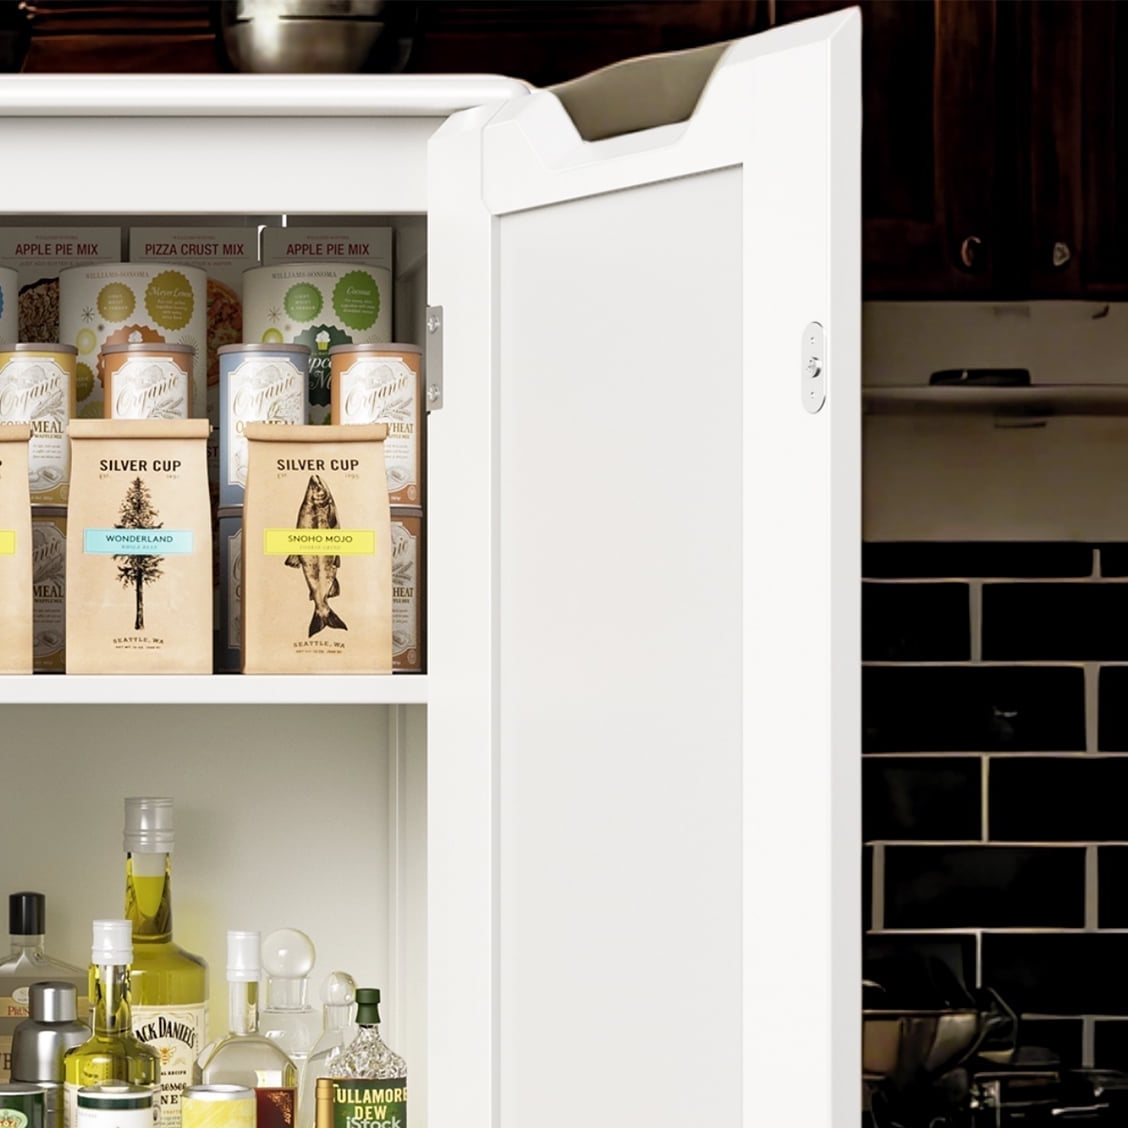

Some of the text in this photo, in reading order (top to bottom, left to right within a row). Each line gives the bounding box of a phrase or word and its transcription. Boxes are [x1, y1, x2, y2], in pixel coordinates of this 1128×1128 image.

[15, 243, 99, 256] APPLE PIE MIX
[144, 243, 245, 256] PIZZA CRUST MIX
[286, 243, 370, 256] APPLE PIE MIX
[116, 372, 179, 418] Organic
[233, 372, 295, 417] Organic
[345, 372, 408, 417] Organic
[389, 422, 414, 434] HEAT
[99, 459, 182, 472] SILVER CUP
[276, 458, 360, 471] SILVER CUP
[105, 534, 174, 543] WONDERLAND
[287, 534, 353, 544] SNOHO MOJO
[333, 641, 345, 649] WA
[134, 1022, 158, 1043] ACK
[354, 1105, 387, 1120] DEW
